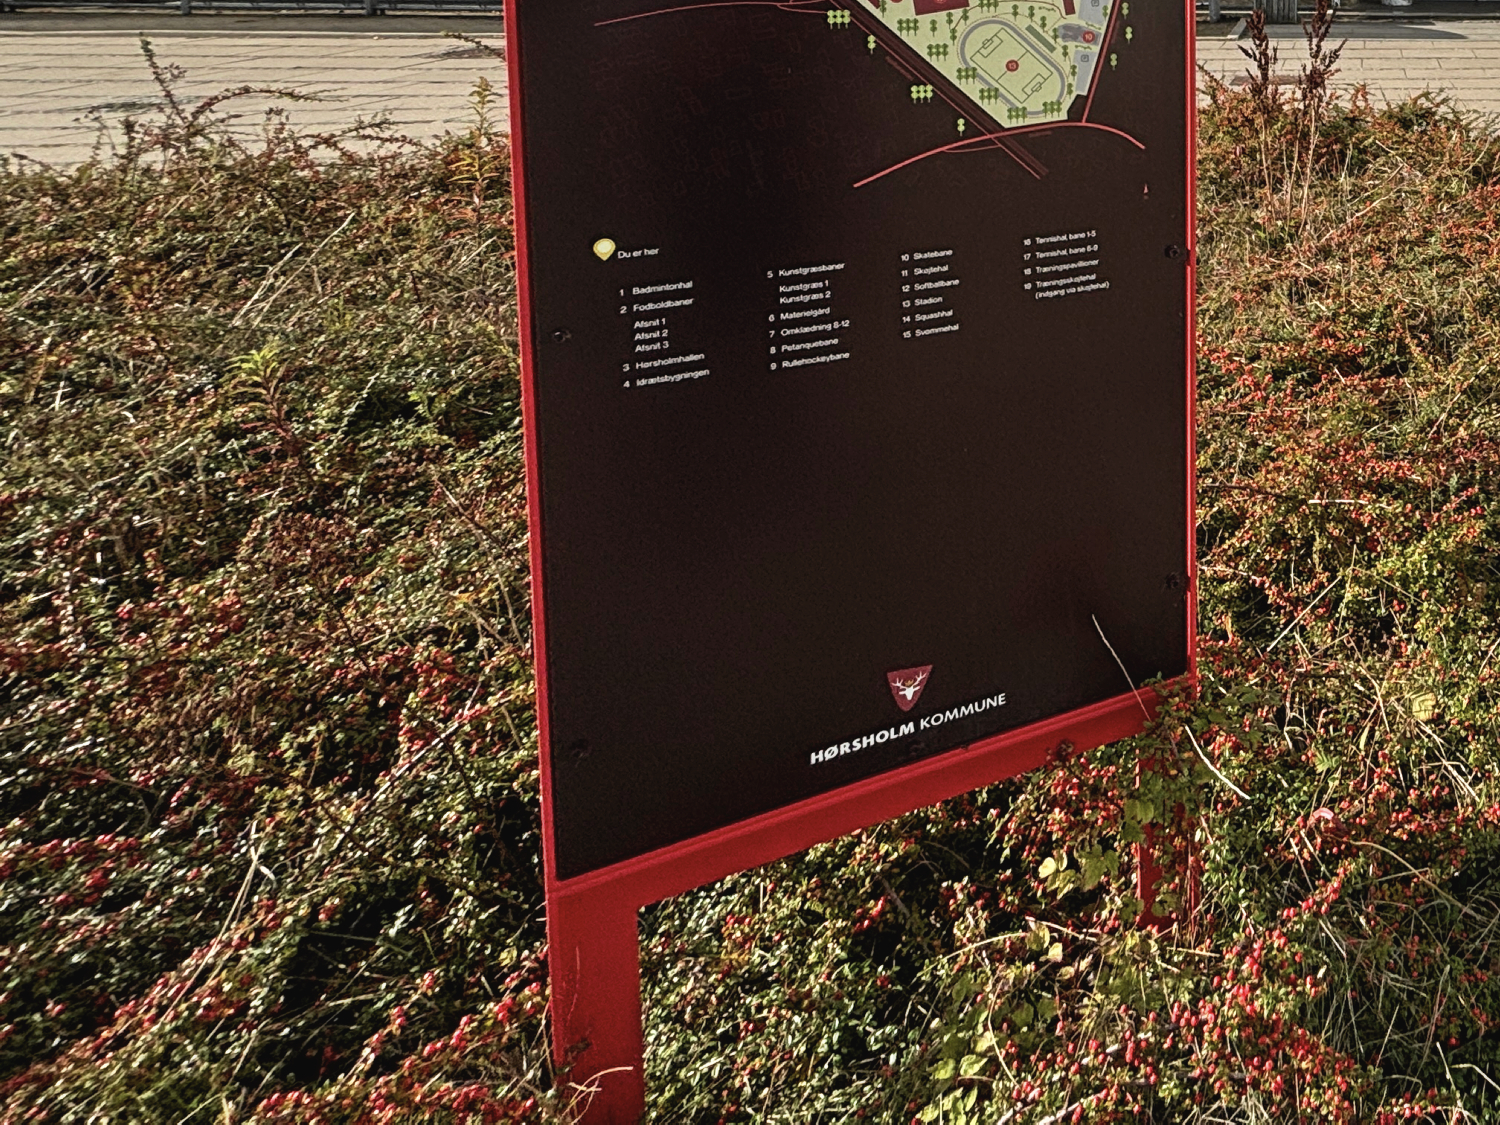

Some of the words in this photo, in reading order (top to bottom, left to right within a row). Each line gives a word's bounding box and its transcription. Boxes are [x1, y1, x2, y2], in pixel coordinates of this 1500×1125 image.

[1087, 230, 1096, 238] 1-5
[618, 250, 631, 259] Du
[632, 249, 642, 257] er
[913, 249, 953, 260] Skatebane
[767, 270, 773, 278] 5
[778, 263, 845, 277] Kunstgræsbaner
[632, 280, 693, 295] Badmintonhal
[779, 282, 823, 293] Kunstgræs
[824, 279, 829, 287] 1
[914, 279, 960, 291] Softballbane
[780, 293, 824, 304] Kunstgræs
[825, 290, 831, 298] 2
[914, 296, 943, 306] Stadion
[620, 306, 627, 314] 2
[633, 298, 695, 312] Fodboldbaner
[768, 314, 775, 322] 6
[780, 307, 831, 320] Materielgård
[915, 309, 953, 321] Squashhal
[634, 319, 659, 329] Afsnit
[769, 330, 775, 338] 7
[781, 323, 832, 336] Omklædning
[833, 319, 850, 329] 8-12
[634, 330, 660, 341] Afsnit
[662, 329, 668, 337] 2
[635, 342, 661, 353] Afsnit
[663, 341, 669, 349] 3
[781, 338, 839, 352] Petanquebane
[782, 352, 850, 368] Rullehockeybane
[622, 364, 630, 372] 3
[623, 380, 630, 388] 4
[636, 369, 710, 387] Idrætsbygningen
[810, 722, 915, 765] HØRSHOLM
[920, 693, 1007, 730] KOMMUNE
